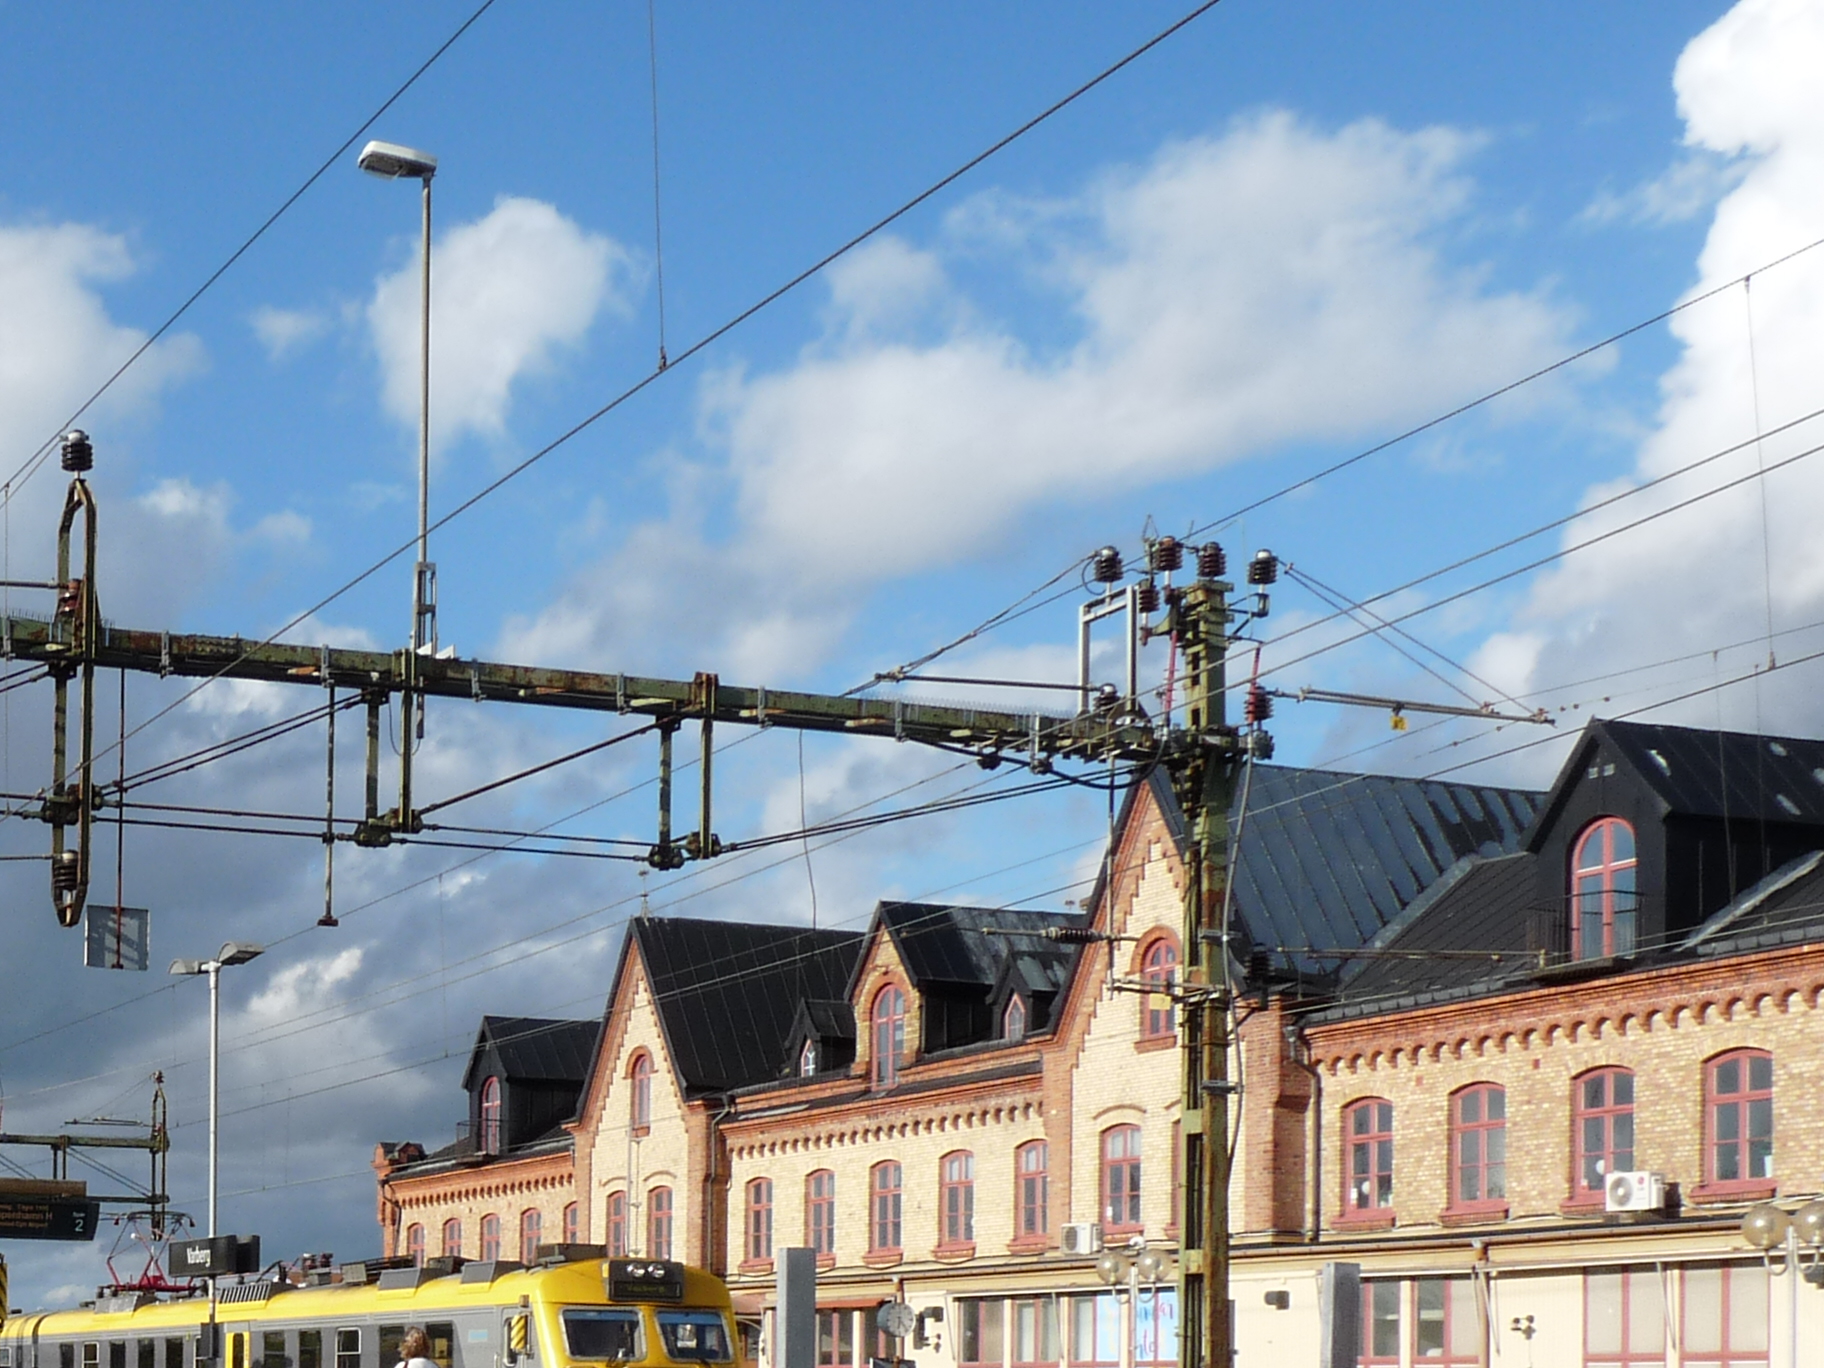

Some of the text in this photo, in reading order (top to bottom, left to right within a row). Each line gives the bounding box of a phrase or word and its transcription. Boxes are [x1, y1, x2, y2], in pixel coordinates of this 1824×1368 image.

[46, 1211, 53, 1220] H
[75, 1219, 84, 1232] 2
[186, 1245, 211, 1268] Varberg
